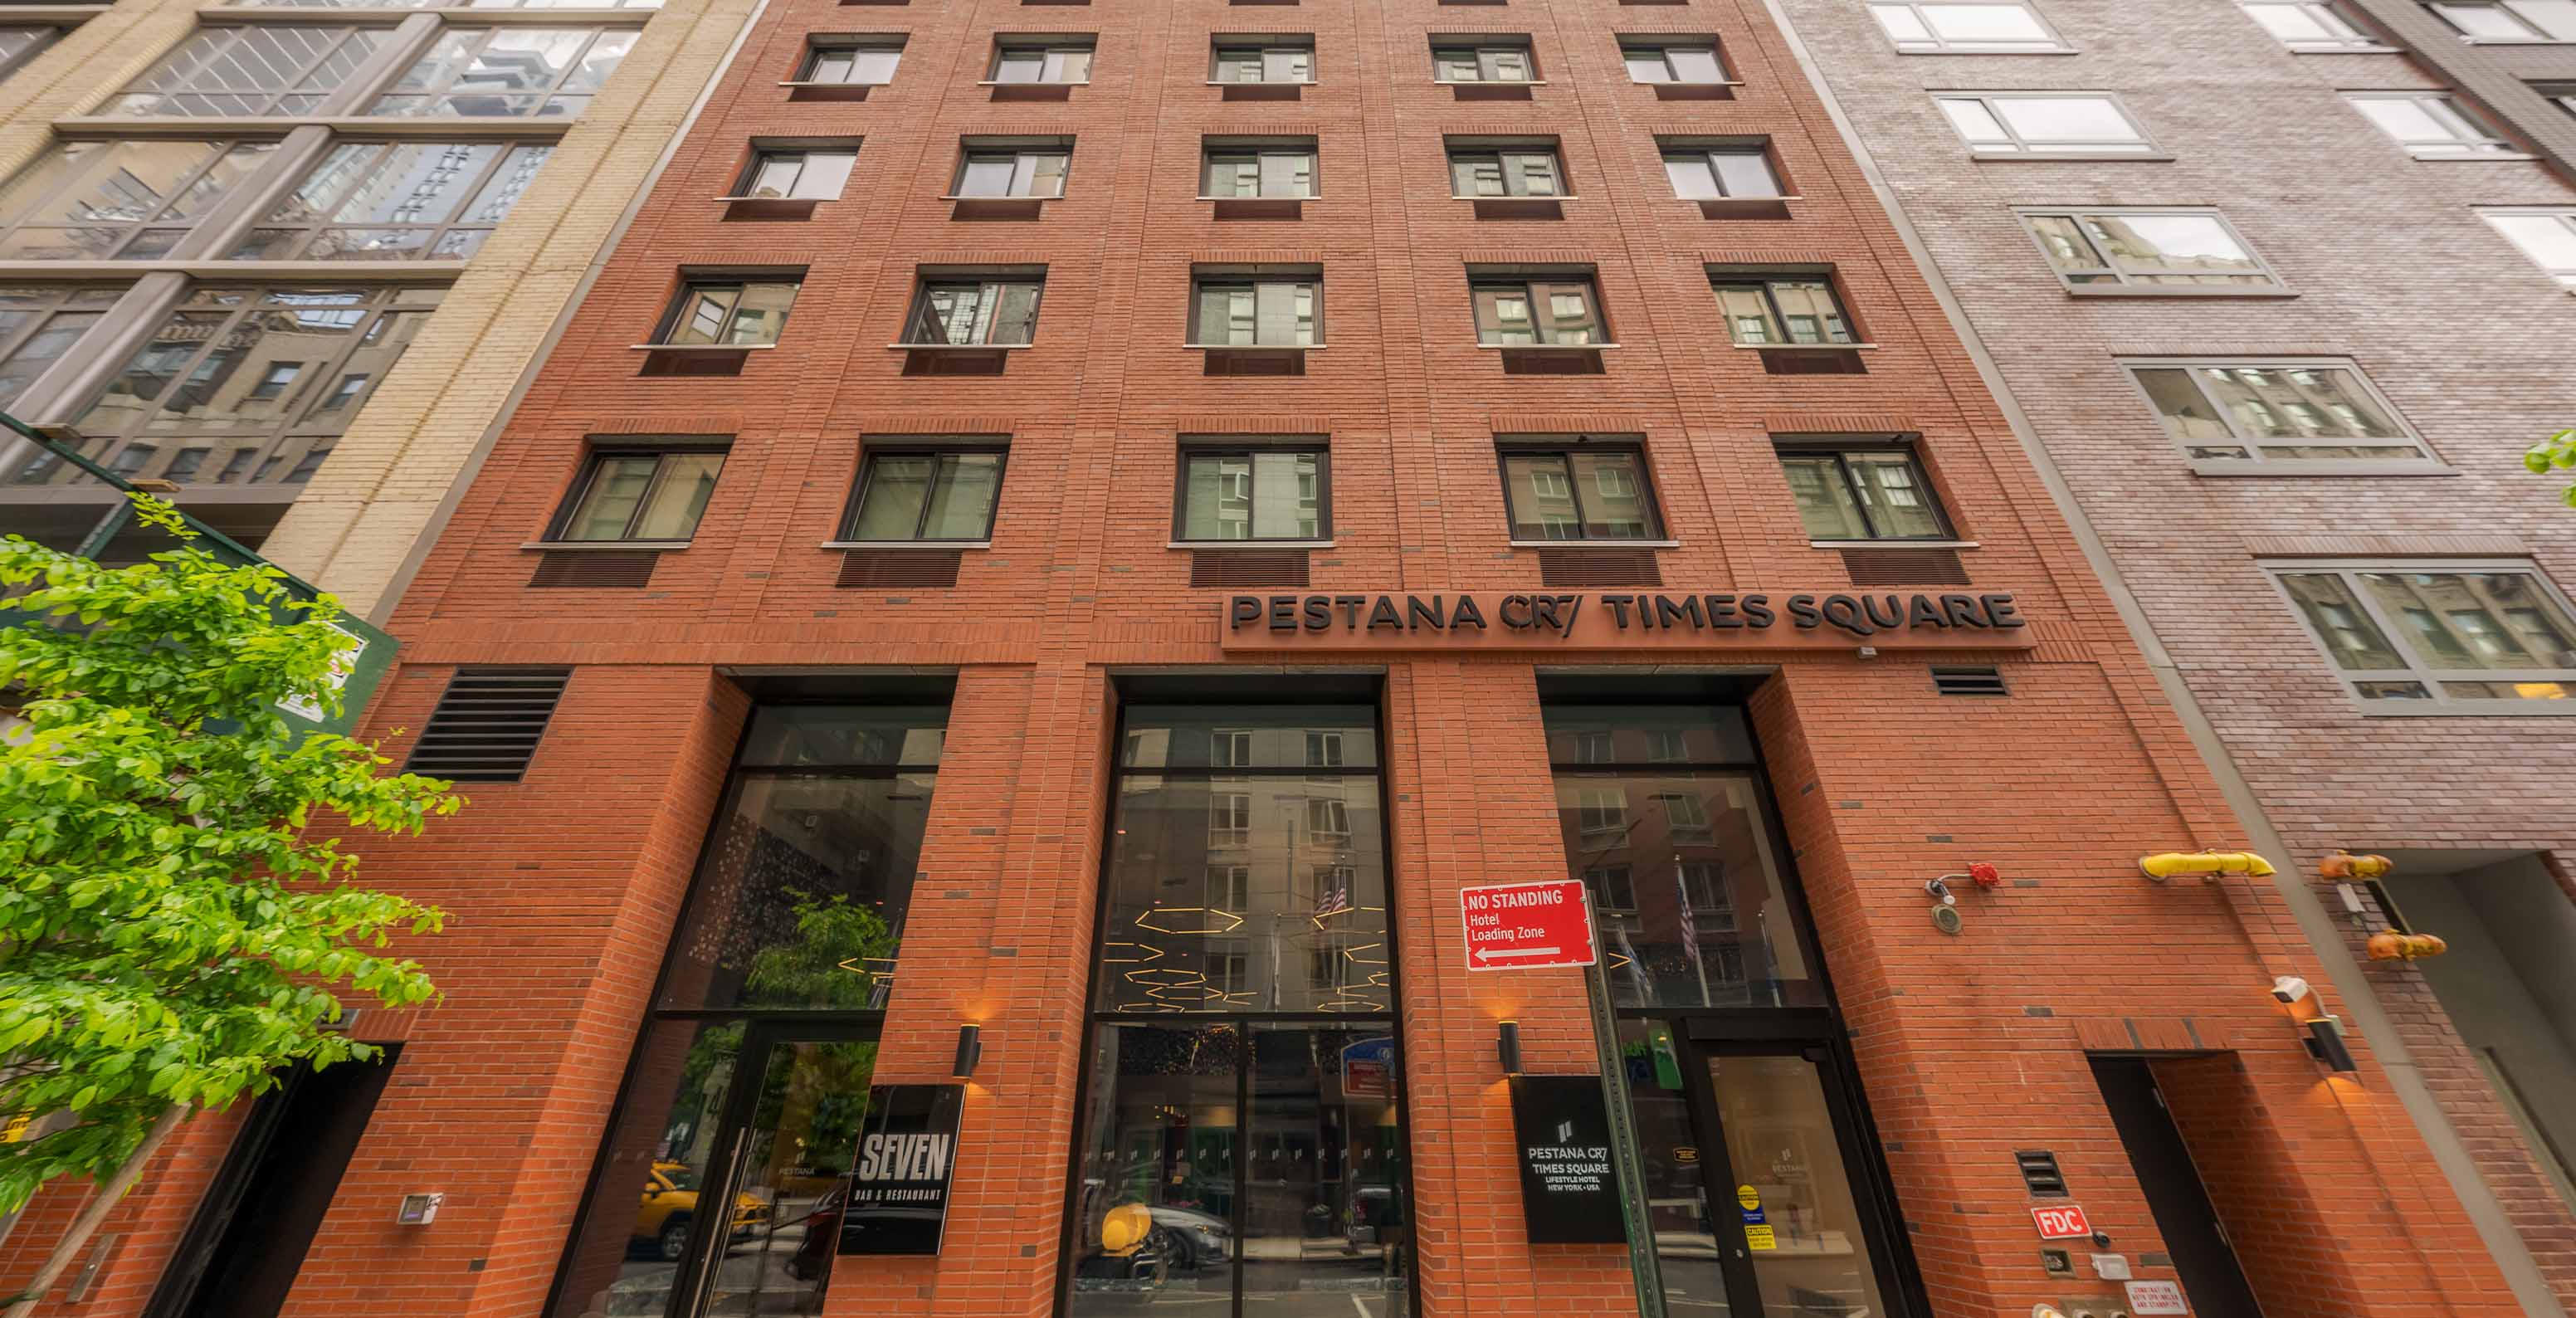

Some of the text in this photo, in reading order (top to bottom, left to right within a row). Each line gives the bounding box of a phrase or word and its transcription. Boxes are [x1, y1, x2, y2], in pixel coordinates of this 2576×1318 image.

[1232, 594, 2025, 638] PESTANA CR7 TIMES SQUARE
[1468, 890, 1564, 910] NO STANDING
[1470, 913, 1500, 926] Hotel
[1471, 926, 1545, 942] Loading Zone
[859, 1134, 949, 1180] SEVEN
[1528, 1147, 1608, 1162] PESTANA CR7
[1532, 1164, 1610, 1175] TIMES SQUARE
[854, 1189, 873, 1201] BAR
[886, 1189, 941, 1201] RESTAURANT
[2038, 1210, 2084, 1234] FDC
